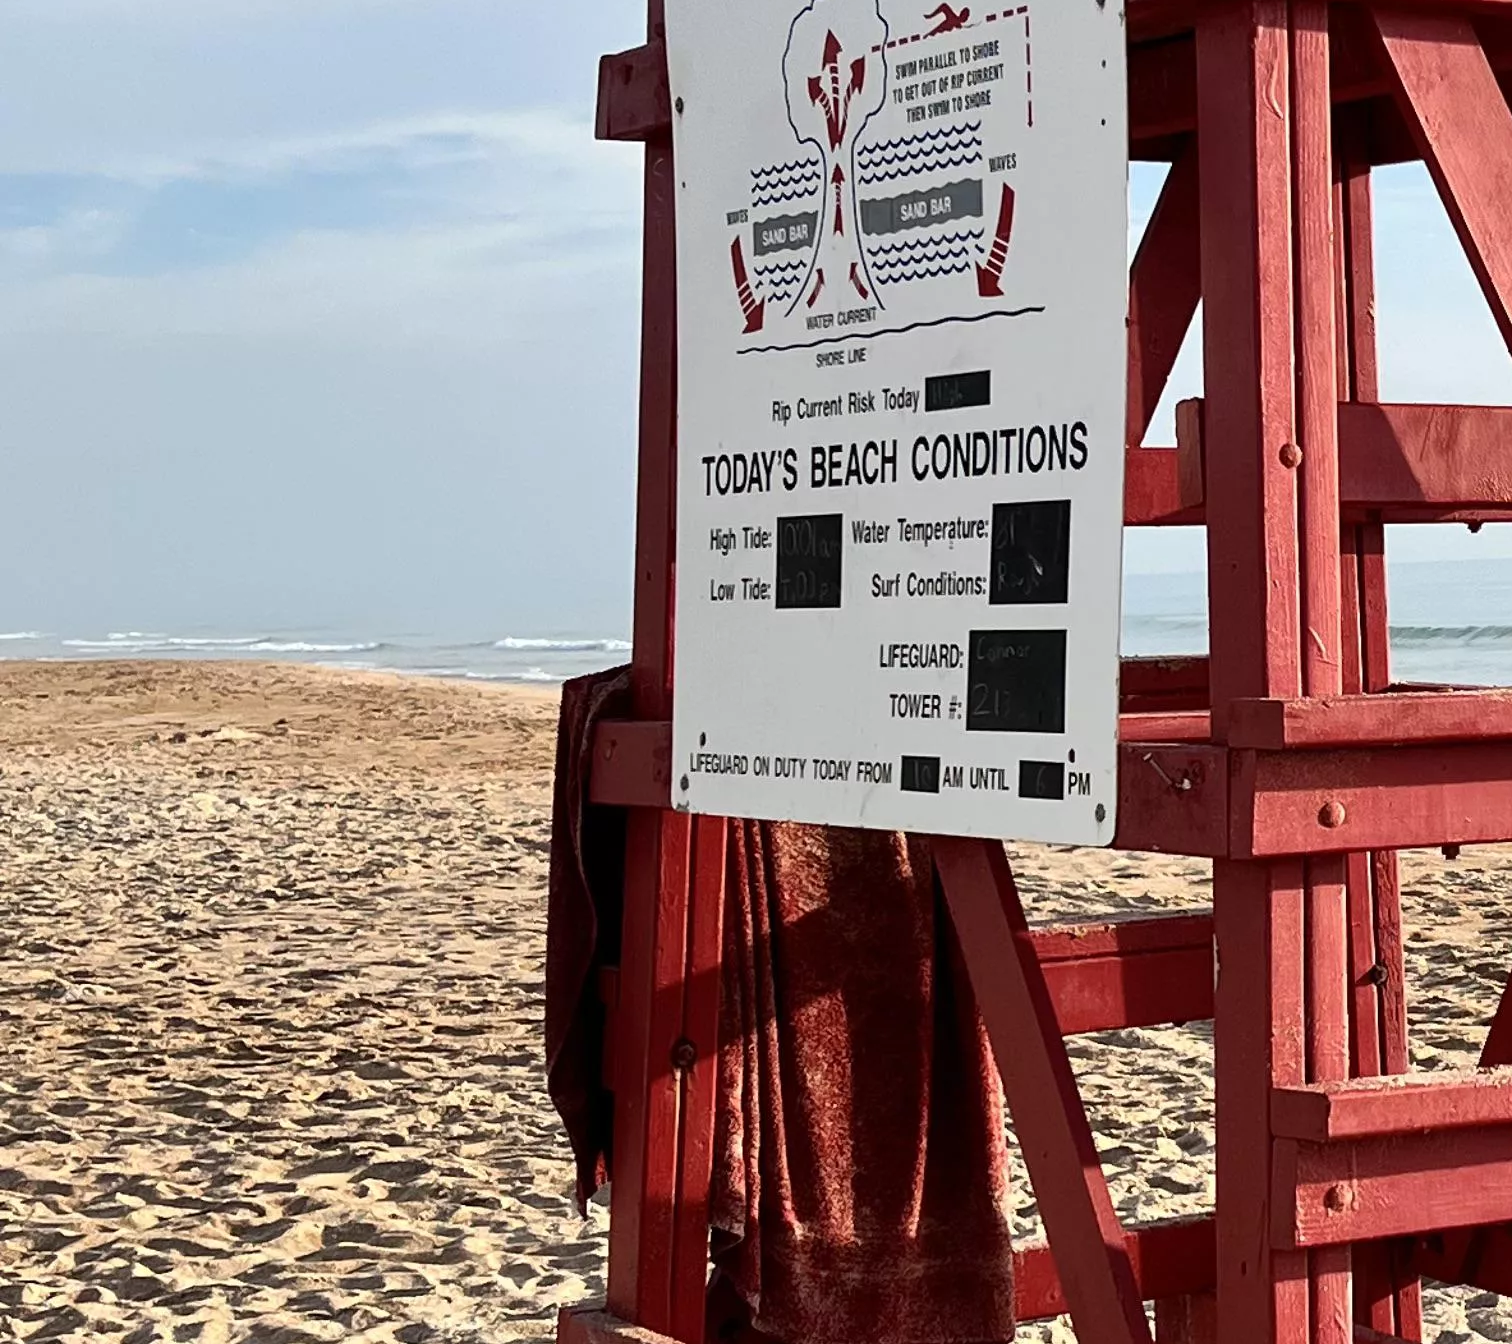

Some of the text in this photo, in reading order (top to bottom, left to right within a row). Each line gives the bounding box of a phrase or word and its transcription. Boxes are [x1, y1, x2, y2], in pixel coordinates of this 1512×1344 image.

[895, 40, 999, 80] SWIM PARALLEL TO SHORE
[893, 63, 1004, 105] TO GET OUT OF RIP CURRENT
[906, 90, 992, 124] THEN SWIM TO SHORE
[989, 153, 1017, 172] WAVES
[726, 209, 749, 226] WAVES
[901, 196, 952, 221] SAND BAR
[762, 223, 808, 248] SAND BAR
[806, 306, 877, 331] WATER CURRENT
[816, 347, 867, 368] SHORE LINE
[772, 387, 920, 426] Rip Current Risk Today
[702, 421, 1089, 496] TODAY'S BEACH CONDITIONS
[710, 526, 772, 557] High Tide:
[852, 518, 989, 547] Water Temperature:
[710, 579, 771, 602] Low Tide:
[872, 573, 987, 598] Surf Conditions:
[880, 644, 964, 669] LIFEGUARD:
[889, 694, 962, 720] TOWER #:
[690, 751, 893, 785] LIFEGUARD ON DUTY TODAY FROM
[943, 766, 1010, 790] AM UNTIL
[1069, 771, 1091, 796] PM
